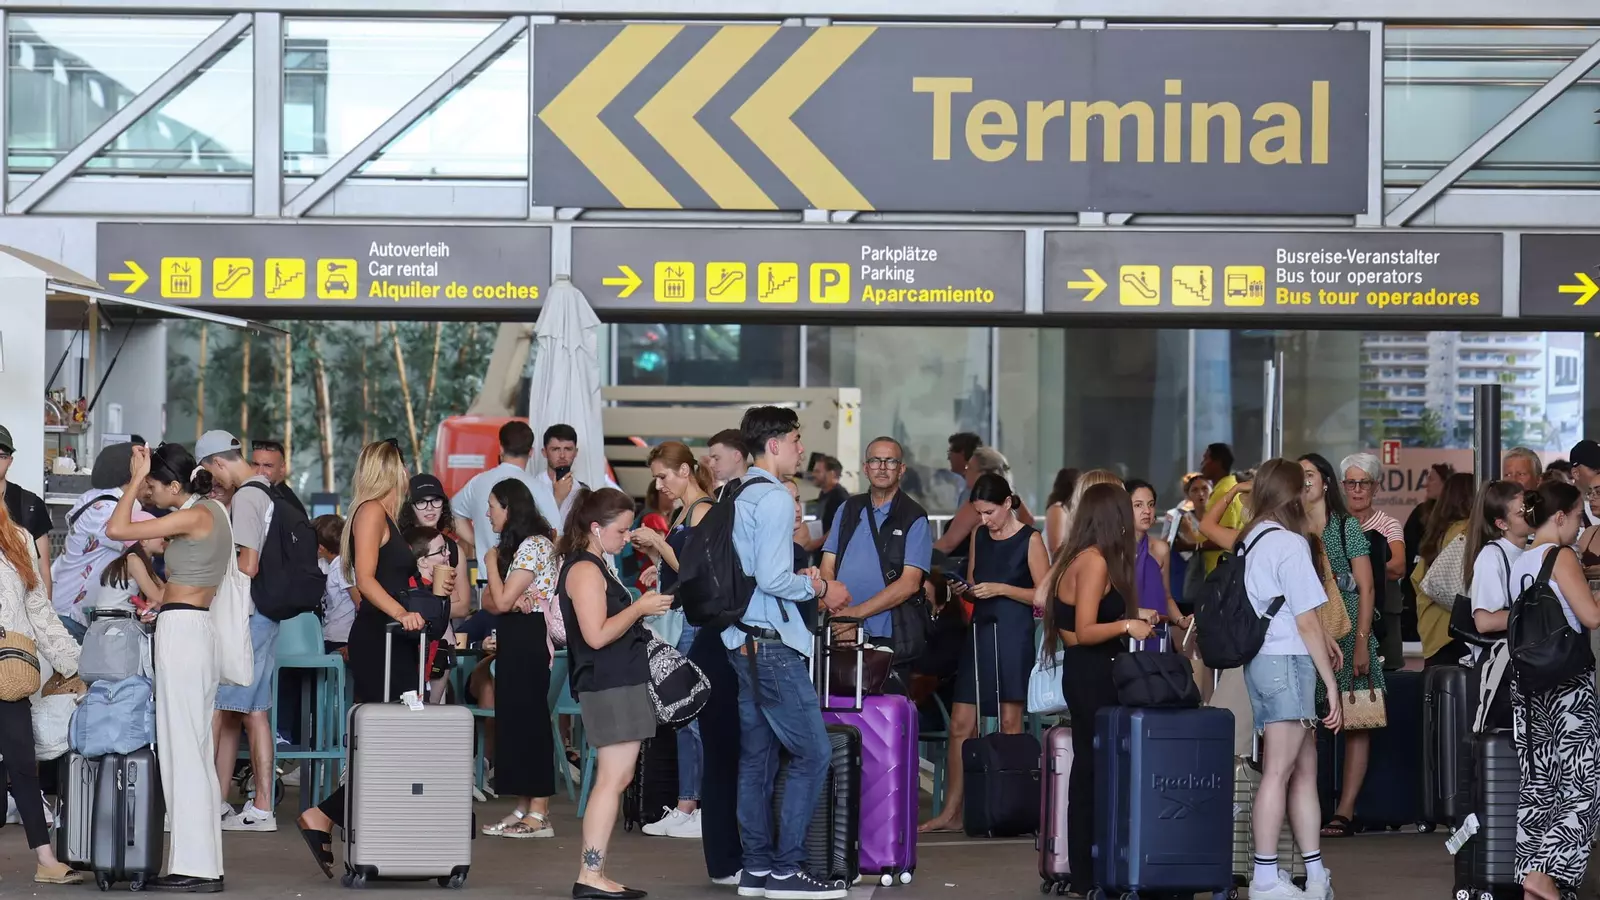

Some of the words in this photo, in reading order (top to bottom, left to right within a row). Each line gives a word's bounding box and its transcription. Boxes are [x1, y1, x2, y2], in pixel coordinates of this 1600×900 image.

[912, 77, 1330, 165] Terminal
[369, 241, 450, 257] Autoverleih
[861, 245, 938, 263] Parkplätze
[1276, 248, 1440, 265] Busreise-Veranstalter
[368, 261, 394, 277] Car
[397, 262, 438, 277] rental
[861, 265, 915, 283] Parking
[1276, 268, 1304, 284] Bus
[1310, 269, 1341, 284] tour
[1347, 269, 1423, 286] operators
[368, 280, 441, 302] Alquiler
[445, 281, 468, 299] de
[472, 281, 539, 299] coches
[819, 269, 841, 299] P
[861, 285, 995, 306] Aparcamiento
[1276, 287, 1312, 305] Bus
[1318, 288, 1360, 305] tour
[1366, 287, 1480, 309] operadores
[1151, 772, 1222, 792] Reebok
